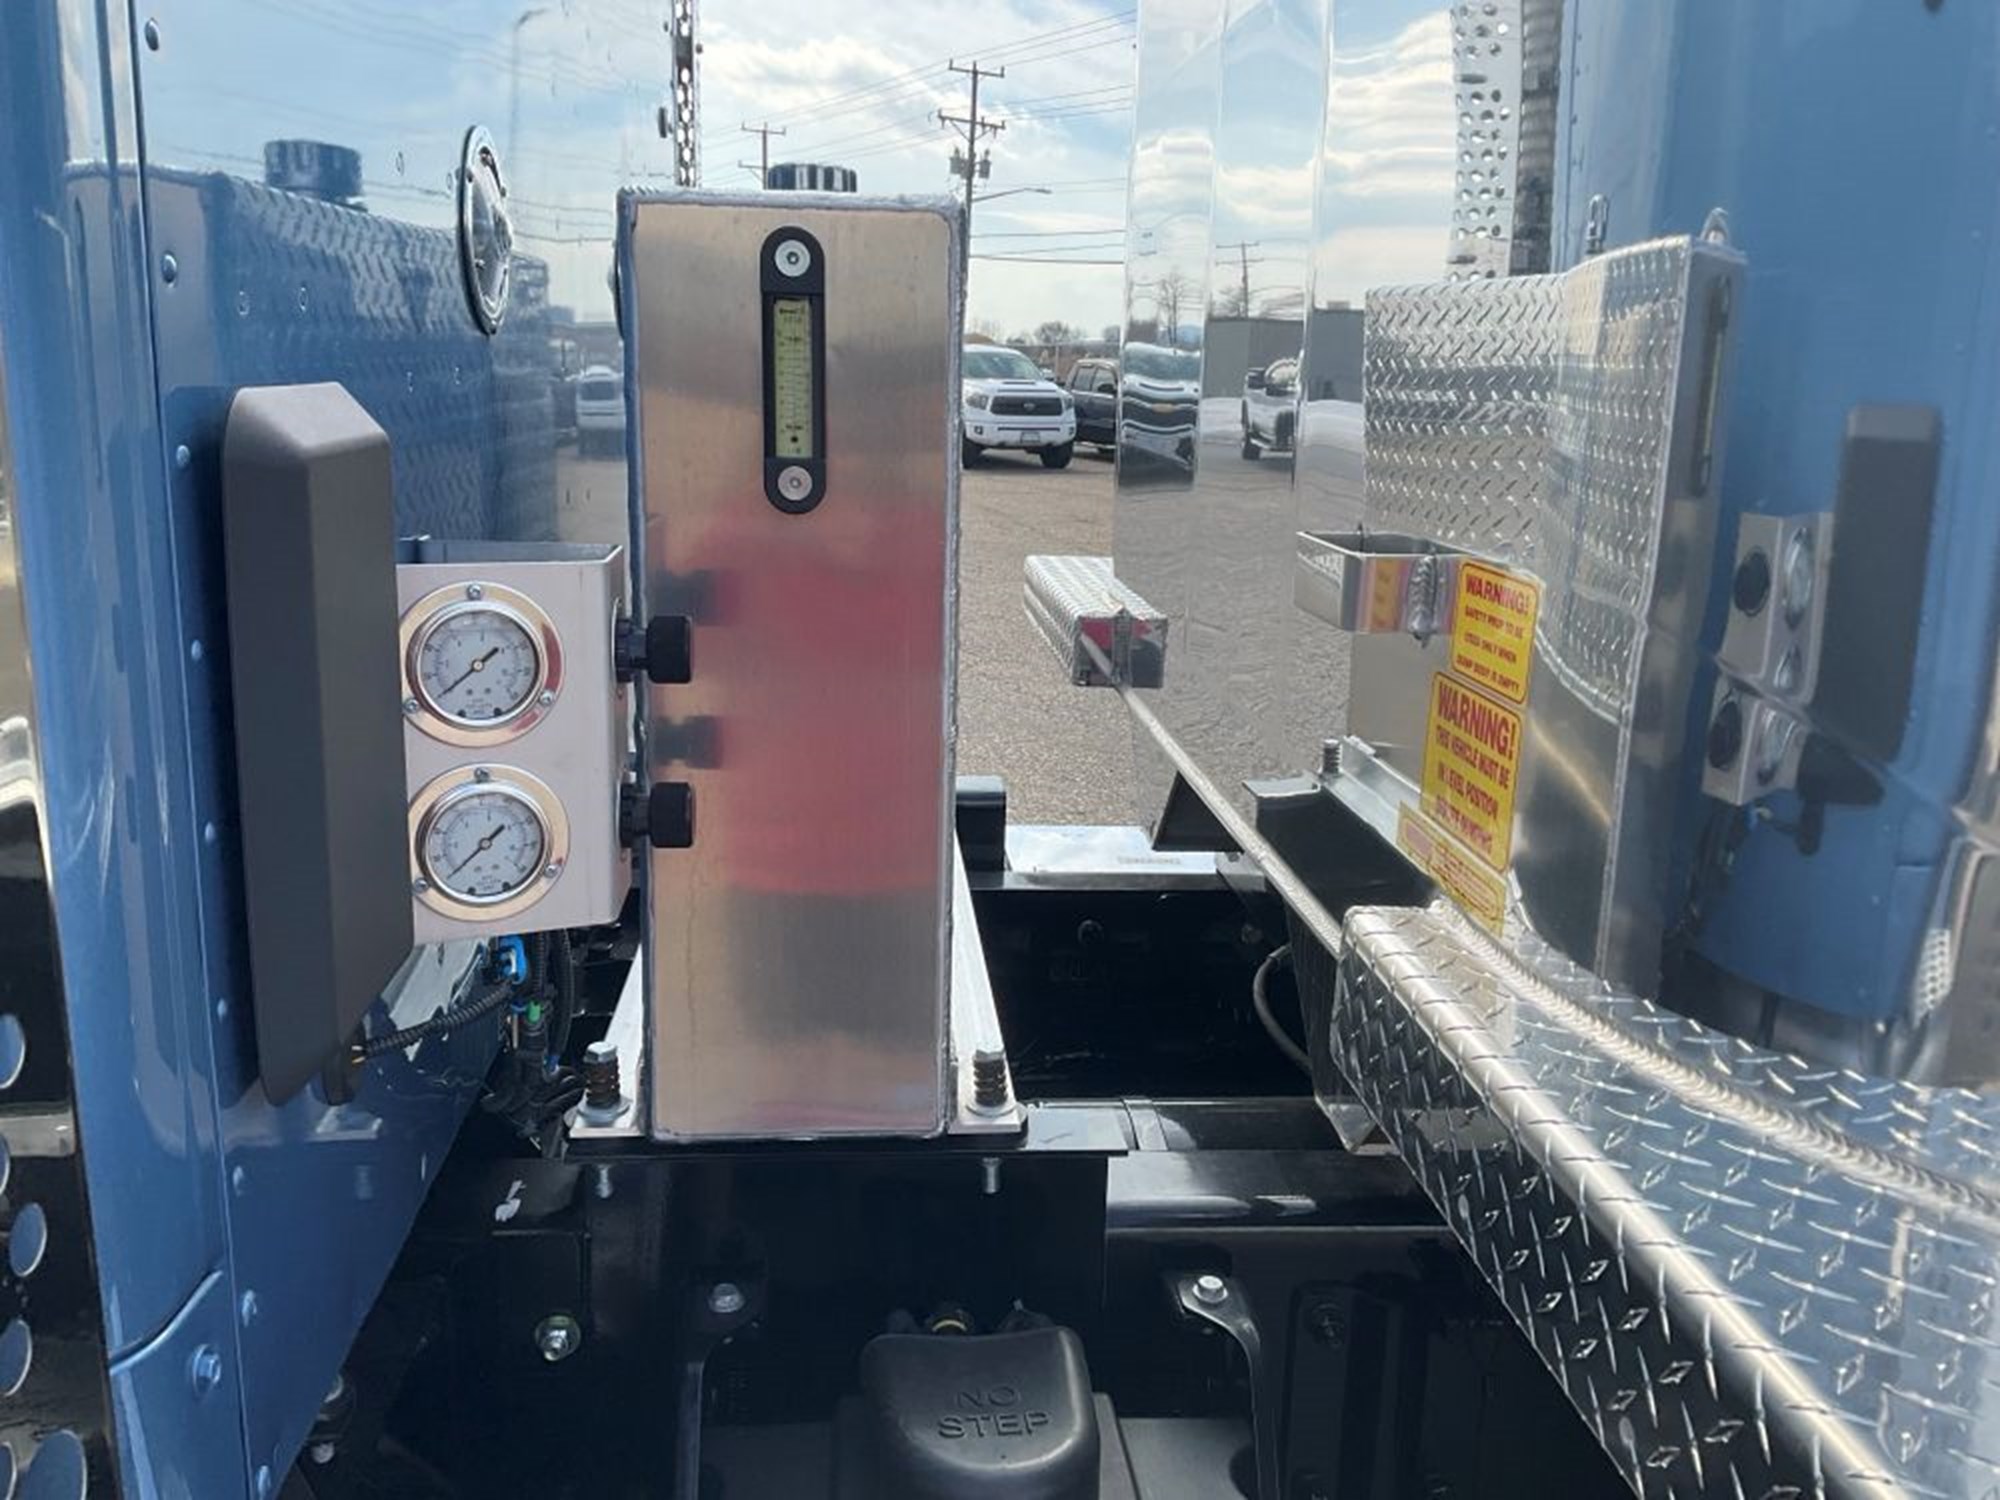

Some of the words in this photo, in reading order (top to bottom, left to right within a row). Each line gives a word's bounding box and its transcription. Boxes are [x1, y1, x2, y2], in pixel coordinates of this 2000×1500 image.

[1466, 574, 1529, 616] WARNING!
[1439, 680, 1516, 761] WARNING!
[1437, 724, 1450, 748] THIS
[1451, 734, 1477, 769] VEHICLE
[1478, 750, 1499, 781] MUST
[1499, 765, 1510, 790] BE
[1445, 766, 1465, 797] LEVEL
[1466, 781, 1499, 821] POSITION
[956, 1385, 1020, 1408] NO
[937, 1411, 1050, 1439] STEP
